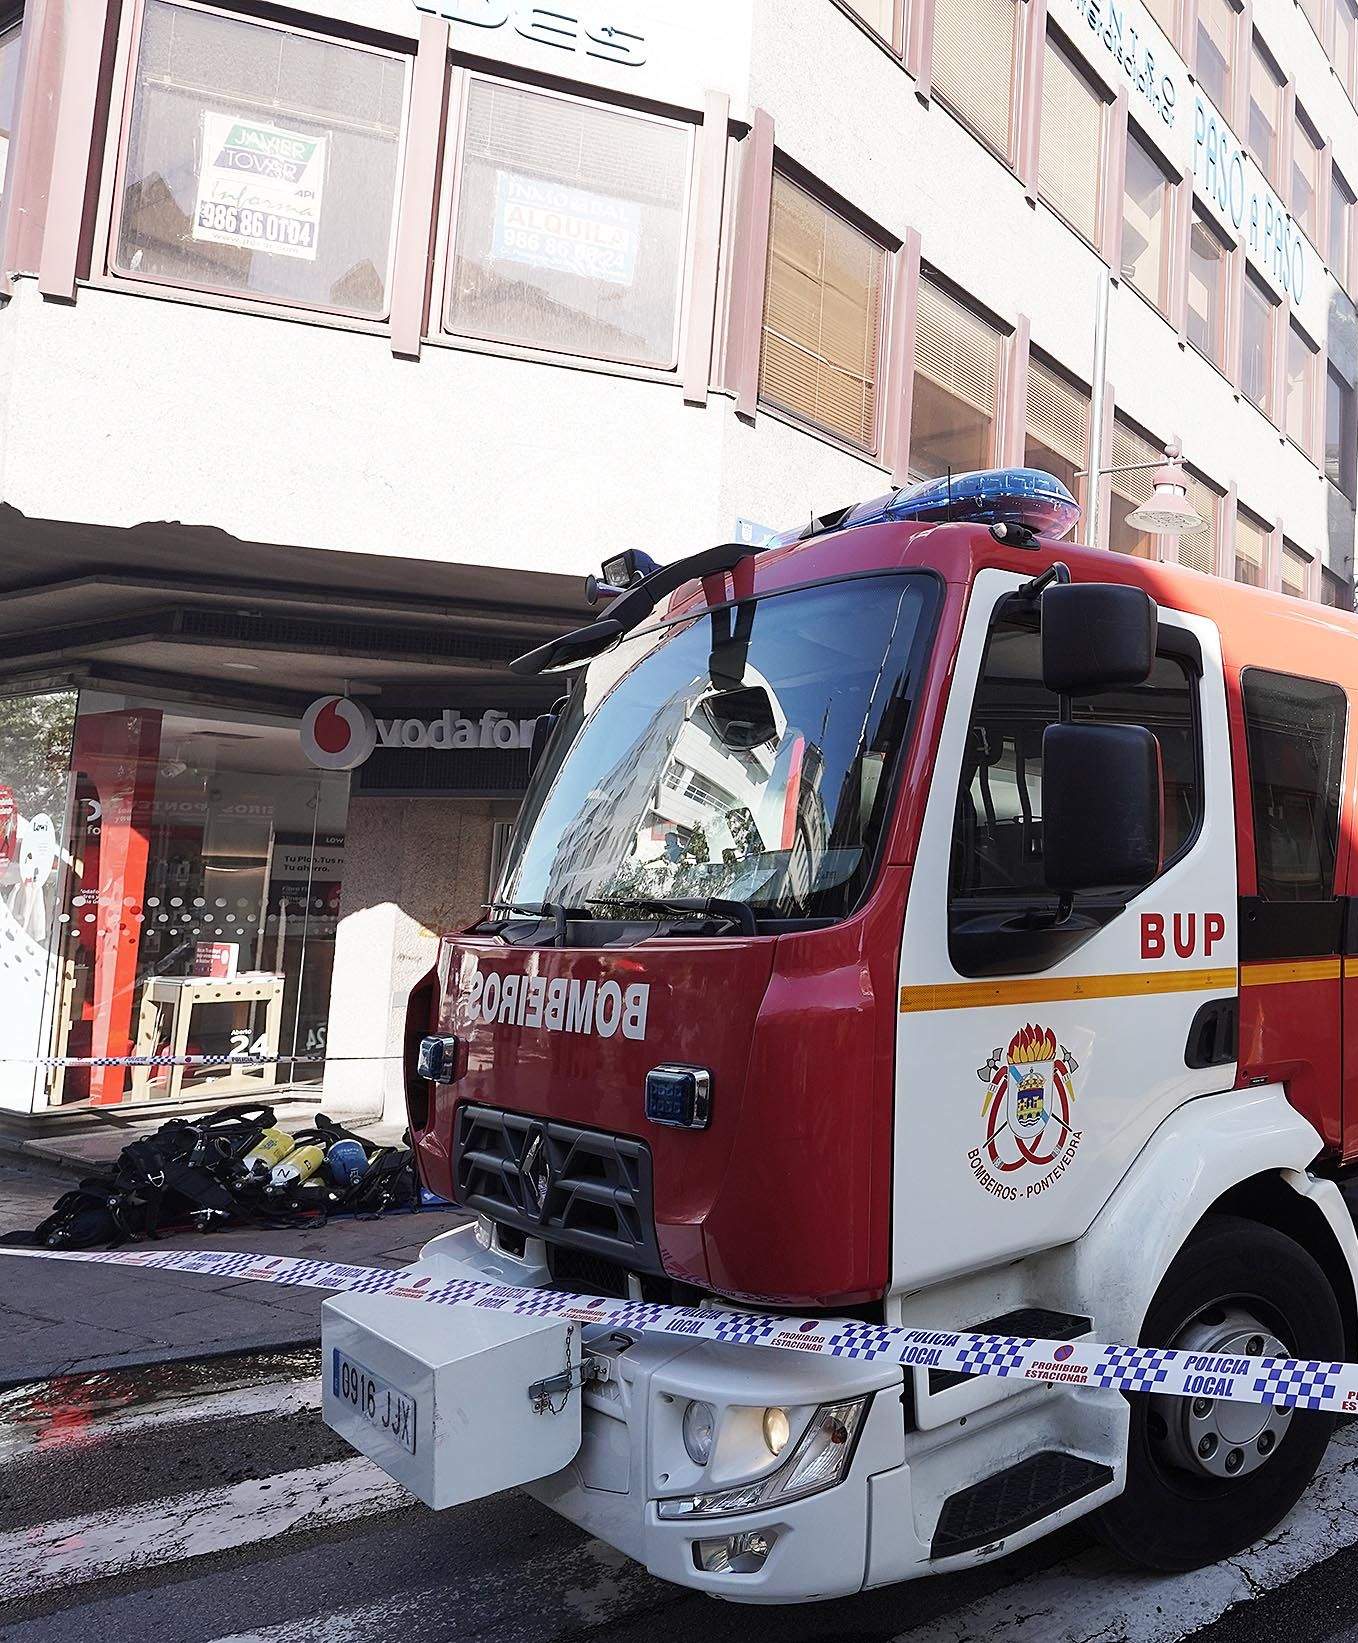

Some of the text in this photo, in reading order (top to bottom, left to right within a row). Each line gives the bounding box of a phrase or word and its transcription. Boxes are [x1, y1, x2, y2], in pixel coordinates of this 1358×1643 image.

[234, 128, 305, 159] JAVIER
[1194, 96, 1245, 229] PASO
[1264, 193, 1304, 305] PASO
[203, 203, 238, 233] 986
[240, 209, 263, 238] 86
[508, 207, 625, 245] ALQUILA
[504, 229, 540, 251] 986
[1140, 912, 1226, 960] BUP
[967, 1147, 1018, 1201] BOMBEIROS
[1026, 1130, 1083, 1199] PONTEVEDRA
[486, 1286, 530, 1298] POLICIA
[674, 1306, 725, 1320] POLICIA
[665, 1318, 705, 1334] LOCAL
[770, 1338, 824, 1352] ESTACIONAR
[777, 1331, 825, 1343] PROHIBIDO
[903, 1330, 961, 1347] POLICIA
[899, 1345, 943, 1366] LOCAL
[1183, 1355, 1251, 1375] POLICIA
[1024, 1370, 1089, 1383] ESTACIONAR
[1031, 1361, 1089, 1374] PROHIBIDO
[342, 1361, 376, 1419] 0916
[1183, 1375, 1233, 1396] LOCAL
